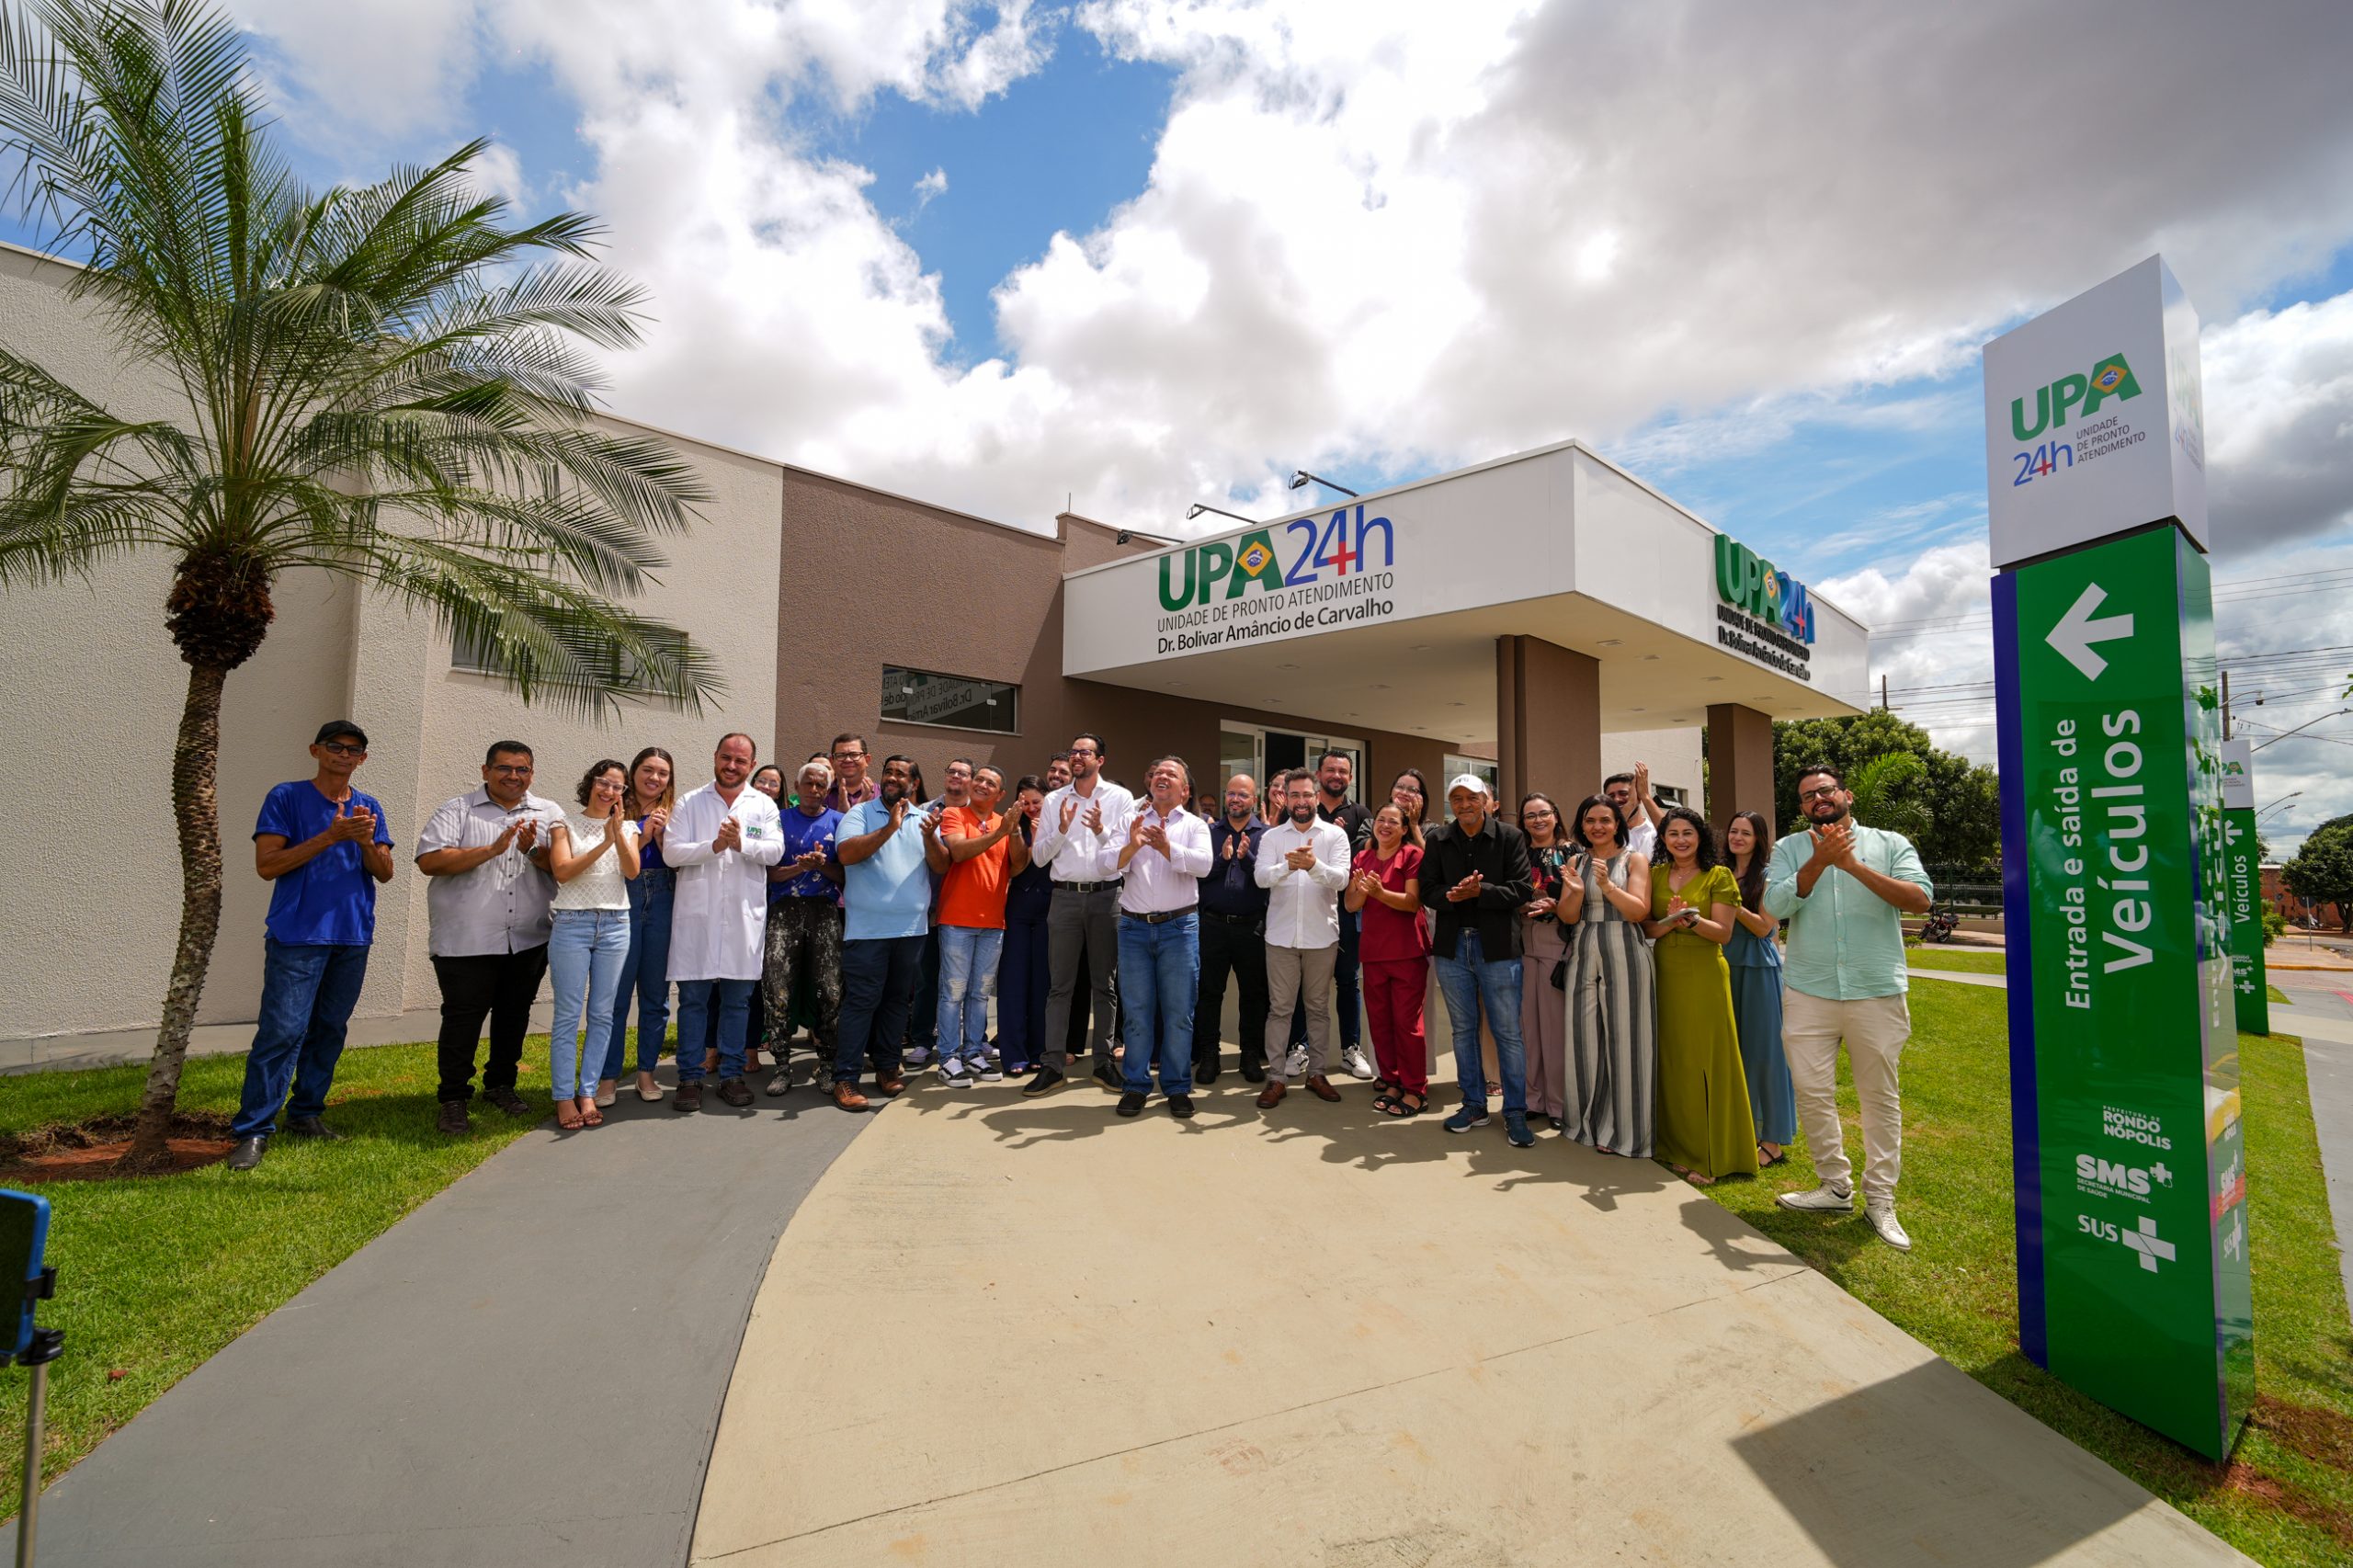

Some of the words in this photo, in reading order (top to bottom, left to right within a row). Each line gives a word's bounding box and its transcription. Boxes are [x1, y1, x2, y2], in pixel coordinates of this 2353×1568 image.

[2012, 353, 2143, 441] UPA
[2076, 416, 2119, 439] UNIDADE
[2076, 440, 2089, 451] DE
[2091, 425, 2131, 448] PRONTO
[2077, 431, 2146, 463] ATENDIMENTO
[2013, 440, 2074, 487] 24h
[1159, 529, 1285, 611] UPA
[1284, 505, 1393, 587] 24h
[1157, 608, 1209, 632] UNIDADE
[1213, 606, 1228, 622] DE
[1233, 594, 1285, 619] PRONTO
[1288, 572, 1393, 608] ATENDIMENTO
[1715, 534, 1783, 627] UPA
[1775, 571, 1815, 644] 24h
[1158, 637, 1176, 653] Dr.
[1177, 631, 1223, 651] Bolivar
[1225, 616, 1291, 642] Amâncio
[1294, 611, 1314, 630] de
[1317, 597, 1393, 625] Carvalho
[2051, 719, 2075, 756] de
[2053, 767, 2082, 846] saída
[2090, 710, 2154, 974] Veículos
[2064, 858, 2084, 876] e
[2231, 855, 2250, 924] Veículos
[2059, 888, 2090, 1008] Entrada
[2103, 1105, 2146, 1119] PREFEITURA
[2103, 1110, 2161, 1133] RONDO
[2076, 1154, 2151, 1195] SMS
[2077, 1177, 2115, 1193] SECRETARIA
[2115, 1189, 2151, 1204] MUNICIPAL
[2078, 1214, 2119, 1243] SUS
